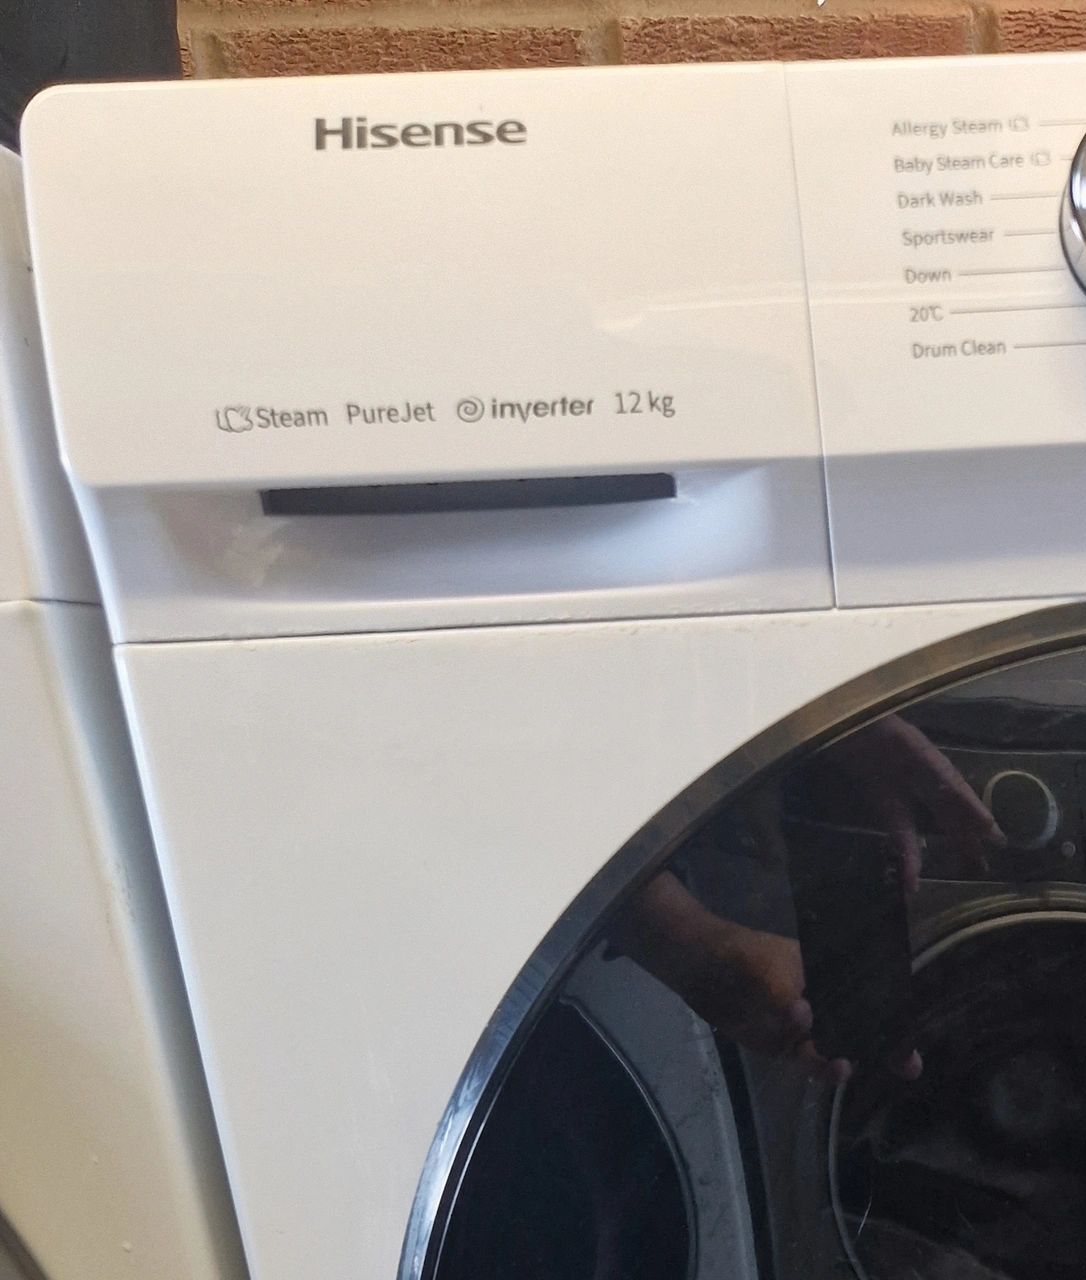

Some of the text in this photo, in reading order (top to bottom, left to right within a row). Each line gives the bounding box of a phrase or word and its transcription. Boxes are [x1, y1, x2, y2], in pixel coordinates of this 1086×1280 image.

[315, 117, 528, 150] Hisense
[891, 117, 1003, 139] Allergy Steam
[894, 152, 1025, 175] Baby Steam Care
[897, 190, 984, 209] Dark Wash
[902, 229, 994, 249] Sportswear
[904, 268, 952, 284] Down
[912, 339, 1007, 359] Drum Clean
[256, 390, 676, 429] Steam PureJet inverter 12 kg
